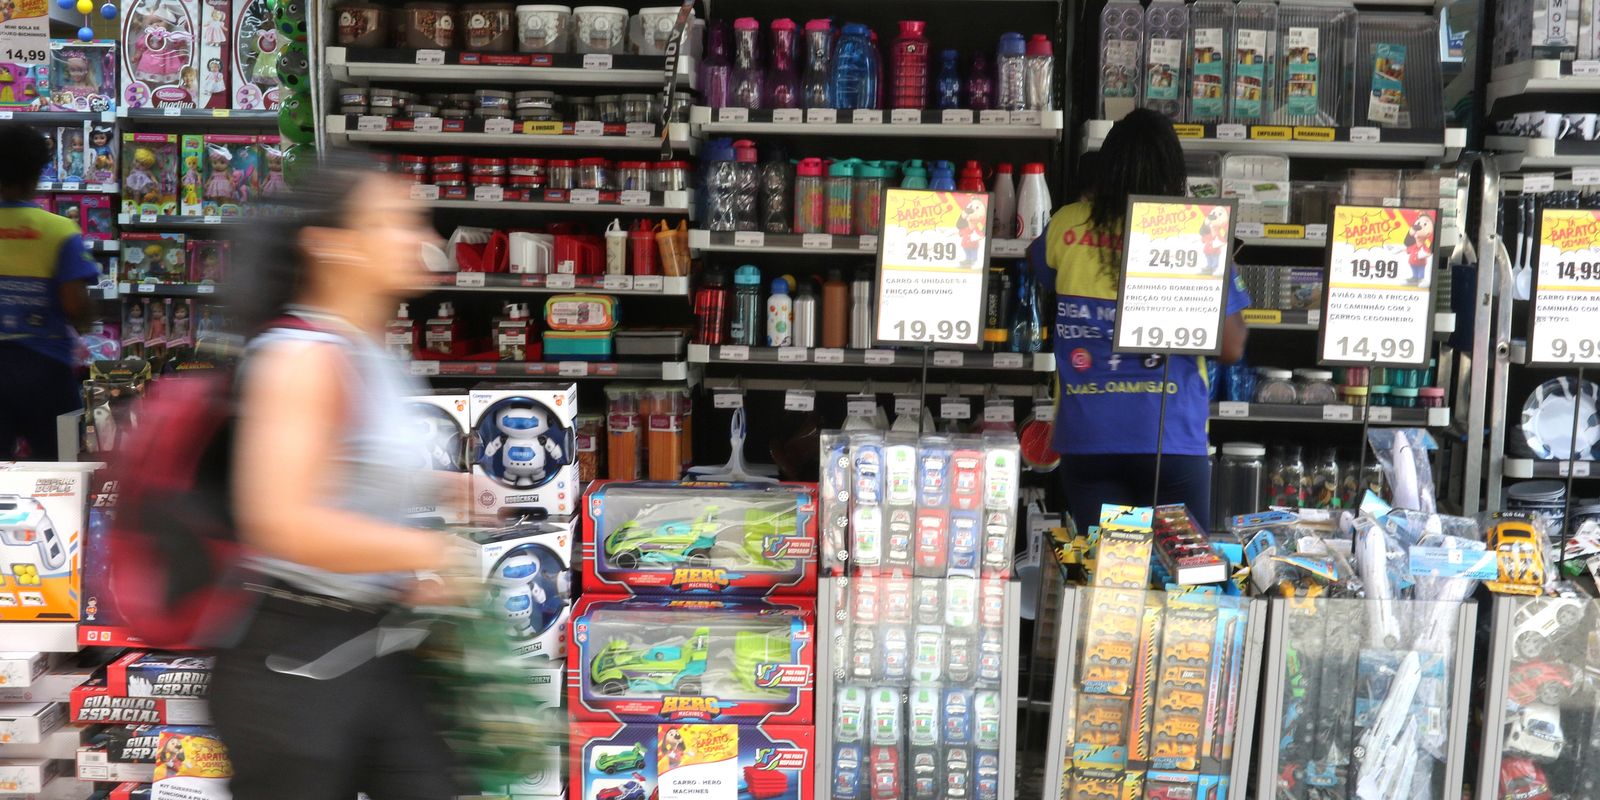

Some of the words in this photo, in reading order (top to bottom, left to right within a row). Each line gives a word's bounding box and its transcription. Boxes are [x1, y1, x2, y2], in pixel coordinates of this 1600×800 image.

[6, 49, 46, 62] 14,99
[896, 203, 943, 222] BARATO
[1141, 210, 1187, 229] BARATO
[907, 217, 937, 229] DEMAIS
[1344, 220, 1391, 239] BARATO
[1551, 222, 1597, 242] BARATO
[1355, 234, 1384, 246] DEMAIS
[1561, 237, 1591, 249] DEMAIS
[906, 242, 957, 262] 24,99
[1148, 248, 1198, 269] 24,99
[1350, 258, 1398, 279] 19,99
[1125, 294, 1159, 302] FRICÇÃO
[1331, 291, 1356, 299] AVIÃO
[1385, 293, 1420, 302] FRICÇÃO
[1057, 302, 1092, 320] SIGA
[893, 319, 972, 343] 19,99
[1056, 323, 1103, 339] REDES
[1131, 326, 1208, 348] 19,99
[1336, 335, 1415, 362] 14,99
[1551, 338, 1600, 363] 9,9
[672, 568, 729, 586] HERO
[661, 696, 720, 714] HERO
[78, 706, 161, 723] ESPACIAL
